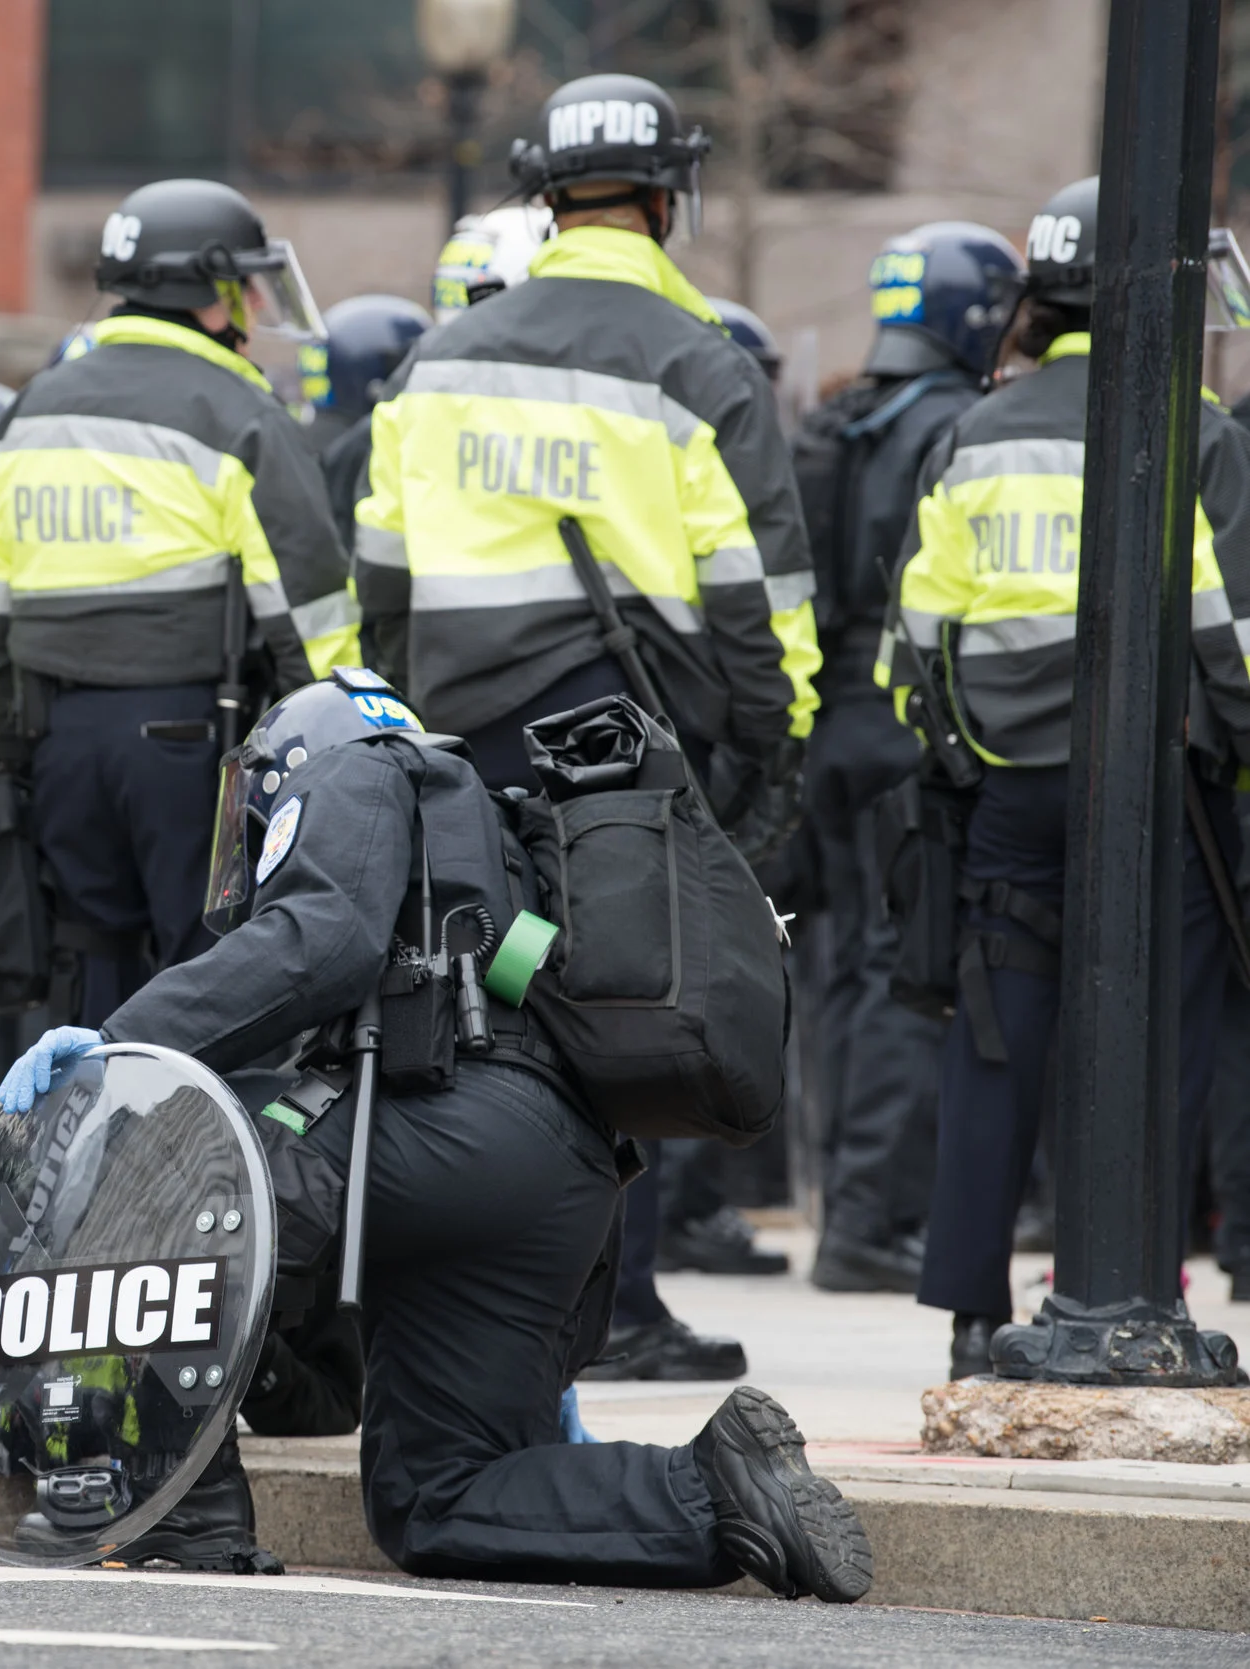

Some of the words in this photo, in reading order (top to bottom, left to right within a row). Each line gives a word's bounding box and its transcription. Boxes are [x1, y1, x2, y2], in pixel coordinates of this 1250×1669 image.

[549, 100, 659, 153] MPDC
[457, 430, 601, 502] POLICE
[14, 483, 145, 544] POLICE
[968, 511, 1077, 576] POLIC
